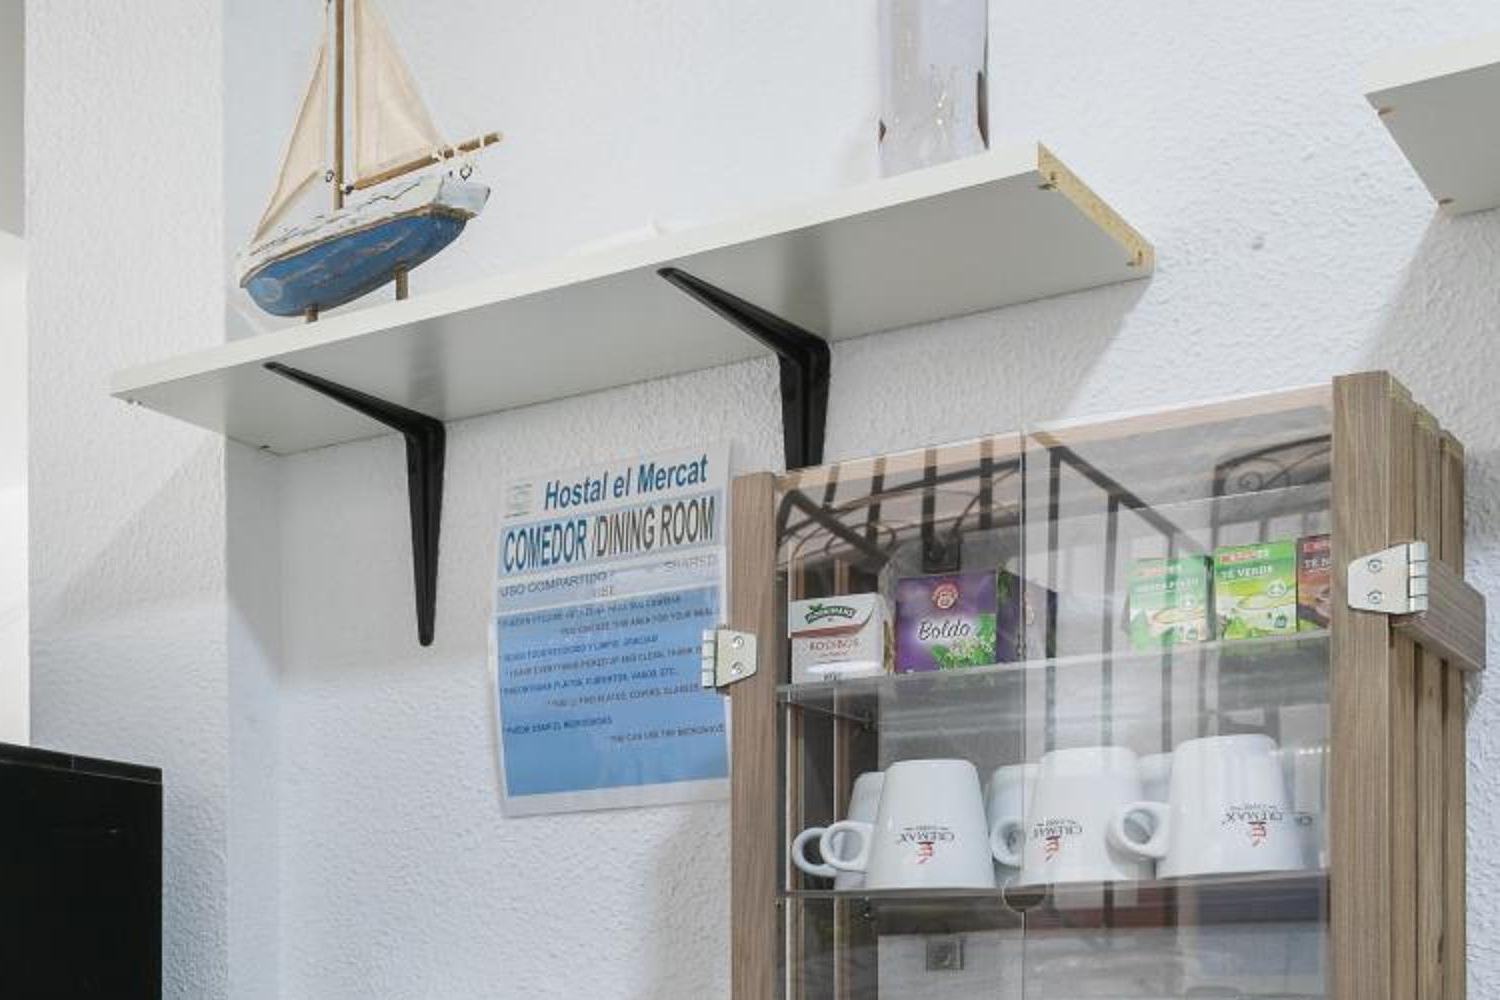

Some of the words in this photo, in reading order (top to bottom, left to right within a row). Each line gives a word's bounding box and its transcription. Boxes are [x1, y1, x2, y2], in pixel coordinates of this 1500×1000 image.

[544, 470, 608, 510] Hostal
[613, 466, 631, 497] el
[637, 453, 708, 494] Mercat
[504, 519, 586, 573] COMEDOR
[660, 496, 715, 546] ROOM
[919, 617, 971, 641] Boldo
[899, 831, 955, 843] CREMAX
